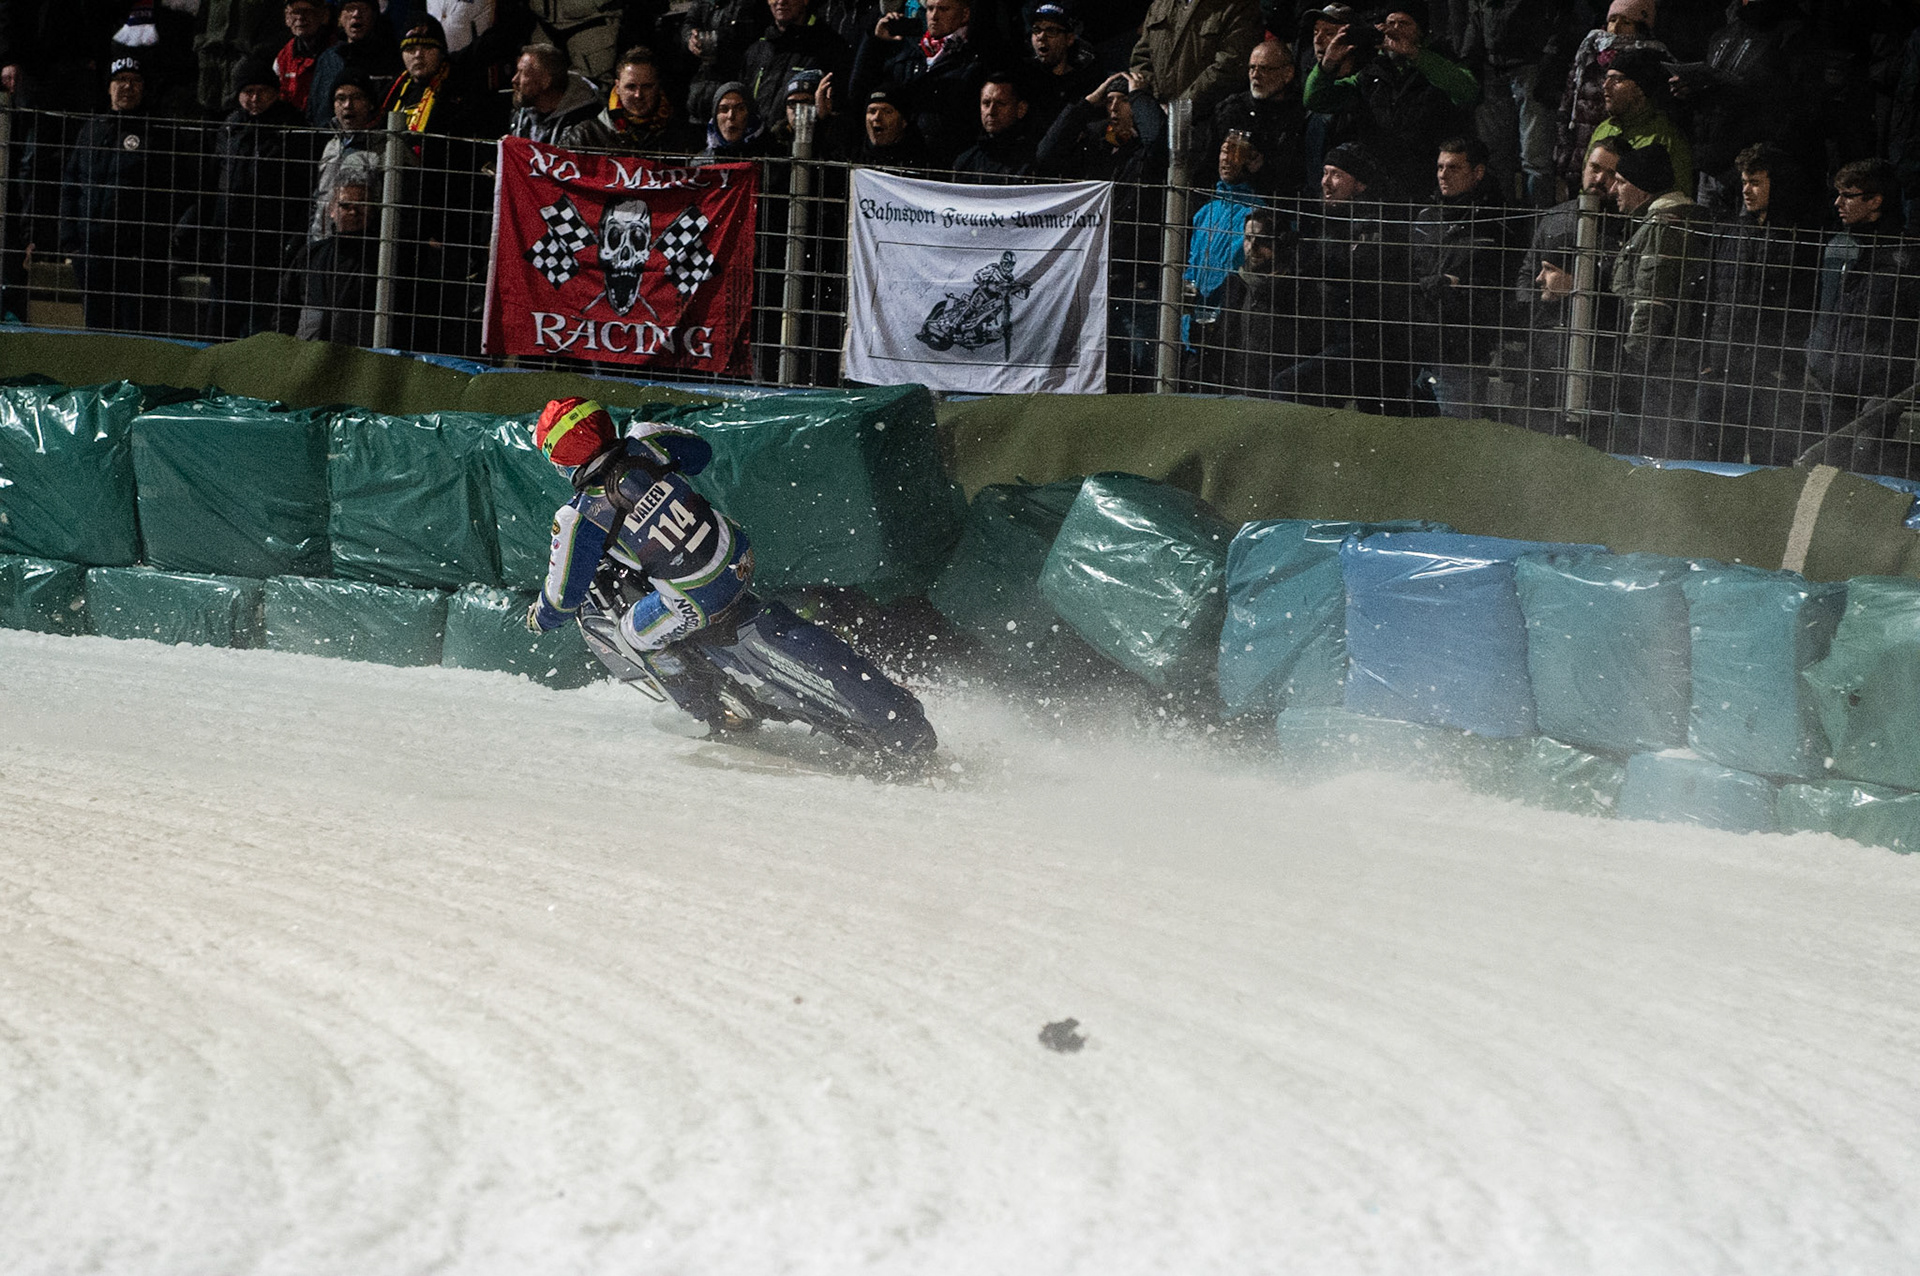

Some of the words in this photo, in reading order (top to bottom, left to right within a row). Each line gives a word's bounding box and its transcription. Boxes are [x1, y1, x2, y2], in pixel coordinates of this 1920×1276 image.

[860, 199, 936, 227] Bahnsport
[941, 208, 1005, 229] Freunde
[531, 312, 713, 359] RACING
[628, 484, 666, 524] VALEEV
[647, 499, 697, 552] 114
